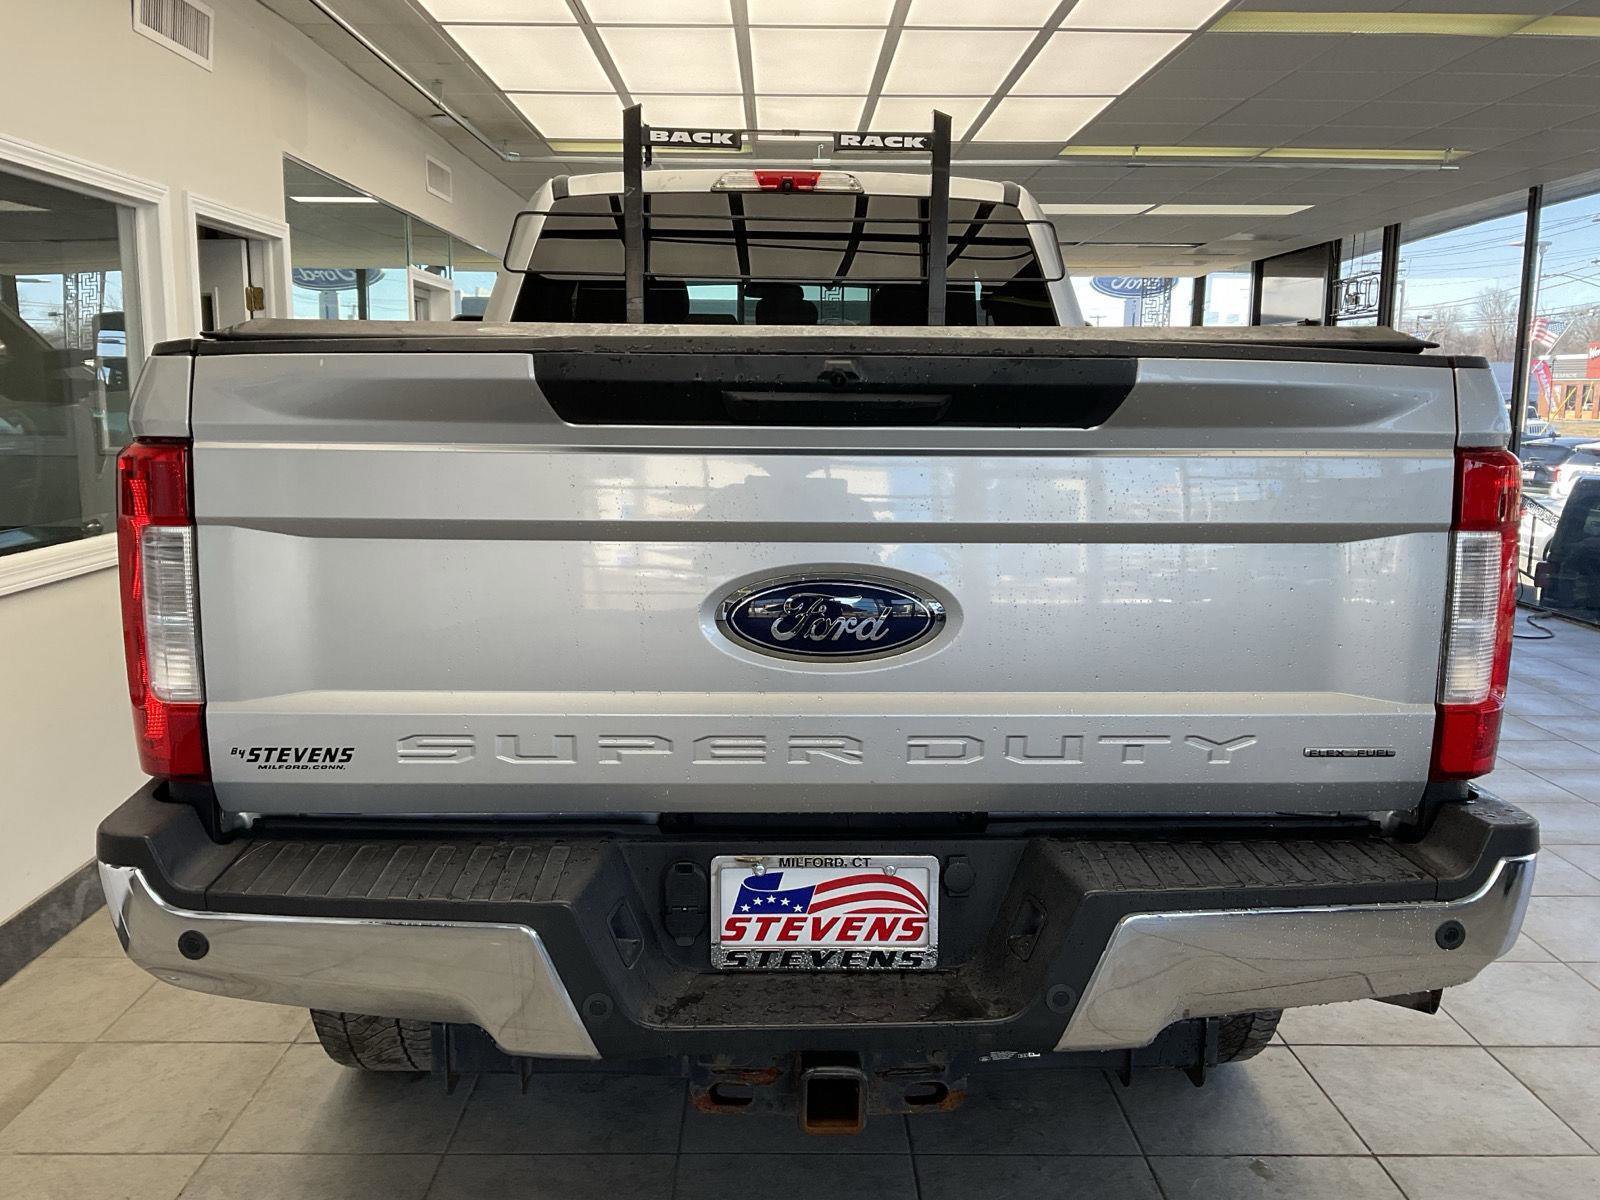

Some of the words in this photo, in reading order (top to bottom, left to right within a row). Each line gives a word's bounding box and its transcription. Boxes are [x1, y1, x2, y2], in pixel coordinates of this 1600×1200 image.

[649, 130, 734, 145] BACK
[840, 134, 925, 149] RACK
[770, 592, 893, 641] Ford
[246, 747, 356, 763] STEVENS
[396, 733, 864, 765] SUPER
[906, 734, 1257, 765] DUTY
[1309, 749, 1346, 758] FLEX
[1356, 749, 1396, 758] FUEL
[851, 857, 872, 868] CT
[719, 916, 930, 942] STEVENS
[723, 950, 925, 968] STEVENS
